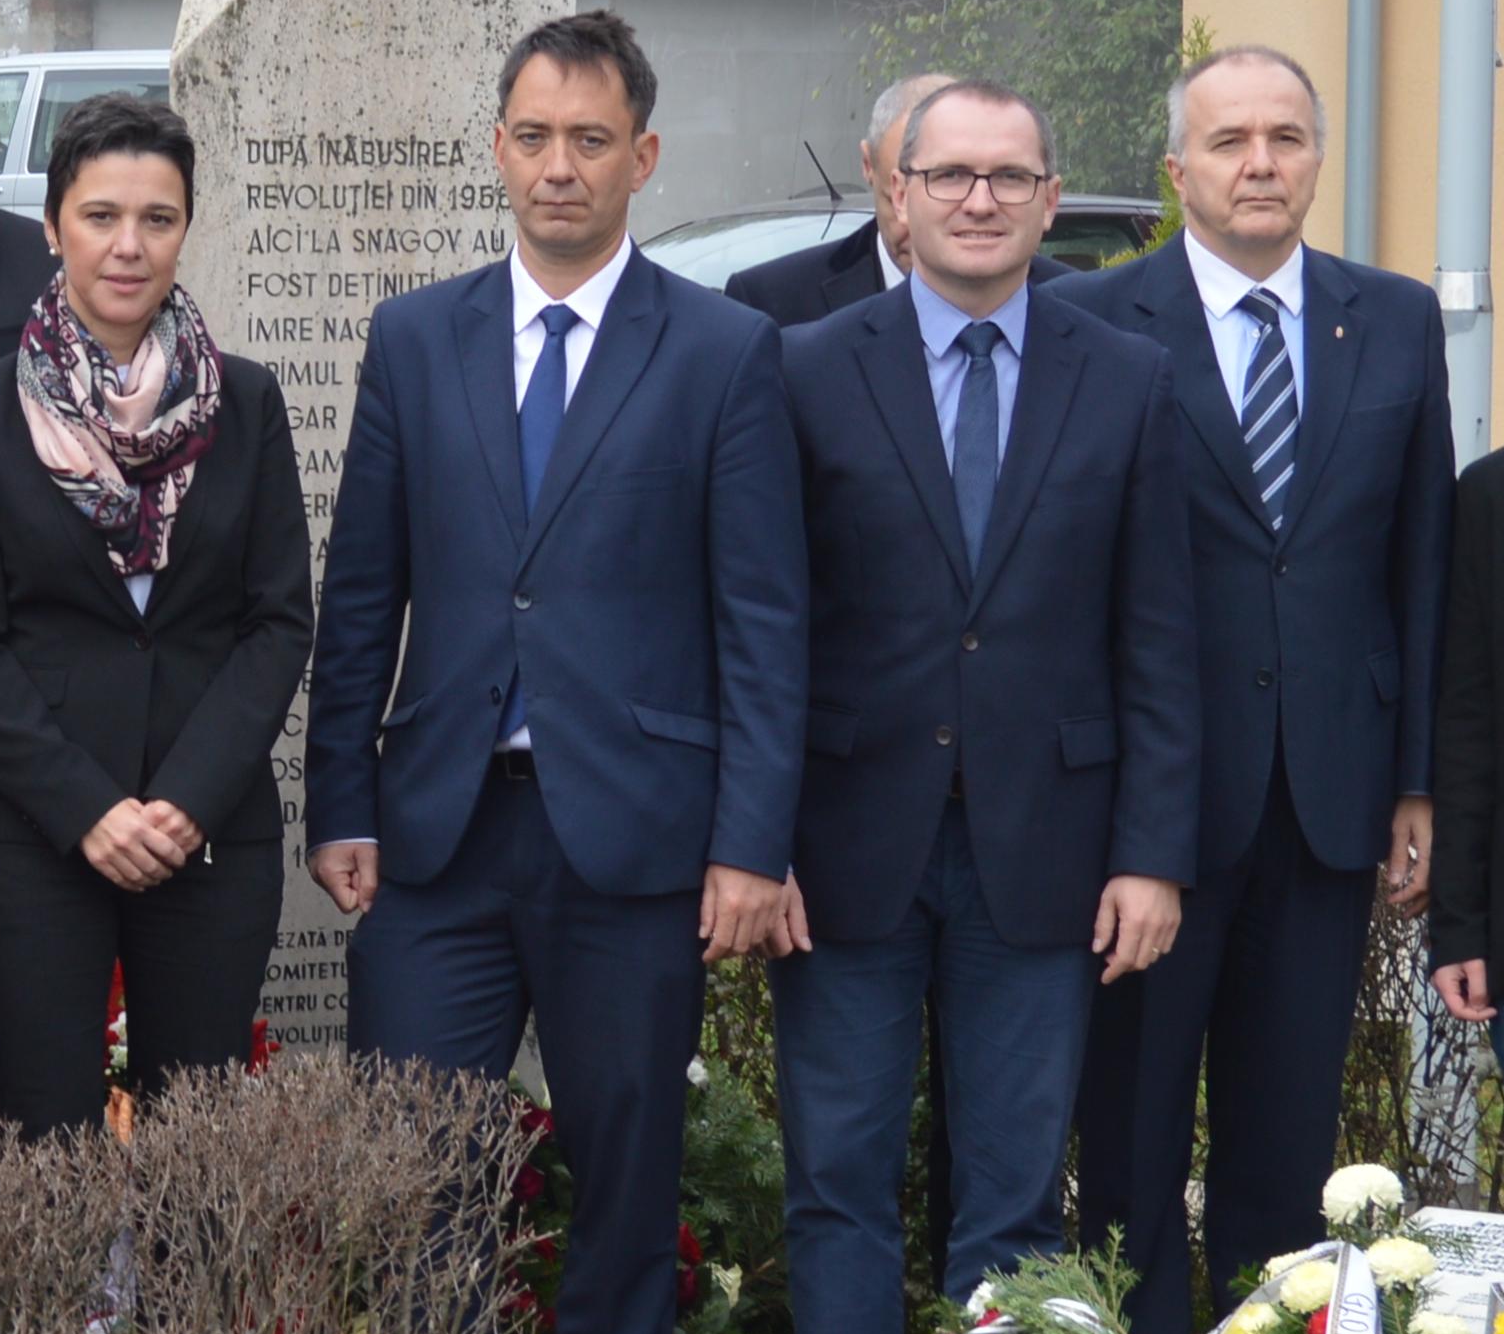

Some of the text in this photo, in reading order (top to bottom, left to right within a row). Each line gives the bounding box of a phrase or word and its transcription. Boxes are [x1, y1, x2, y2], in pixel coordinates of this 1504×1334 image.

[449, 184, 511, 209] 1956
[311, 229, 341, 254] LA
[353, 229, 462, 255] SNAGOV
[472, 229, 505, 254] AU
[248, 273, 317, 298] FOST
[323, 316, 371, 342] NAG
[262, 994, 317, 1014] ENTRU
